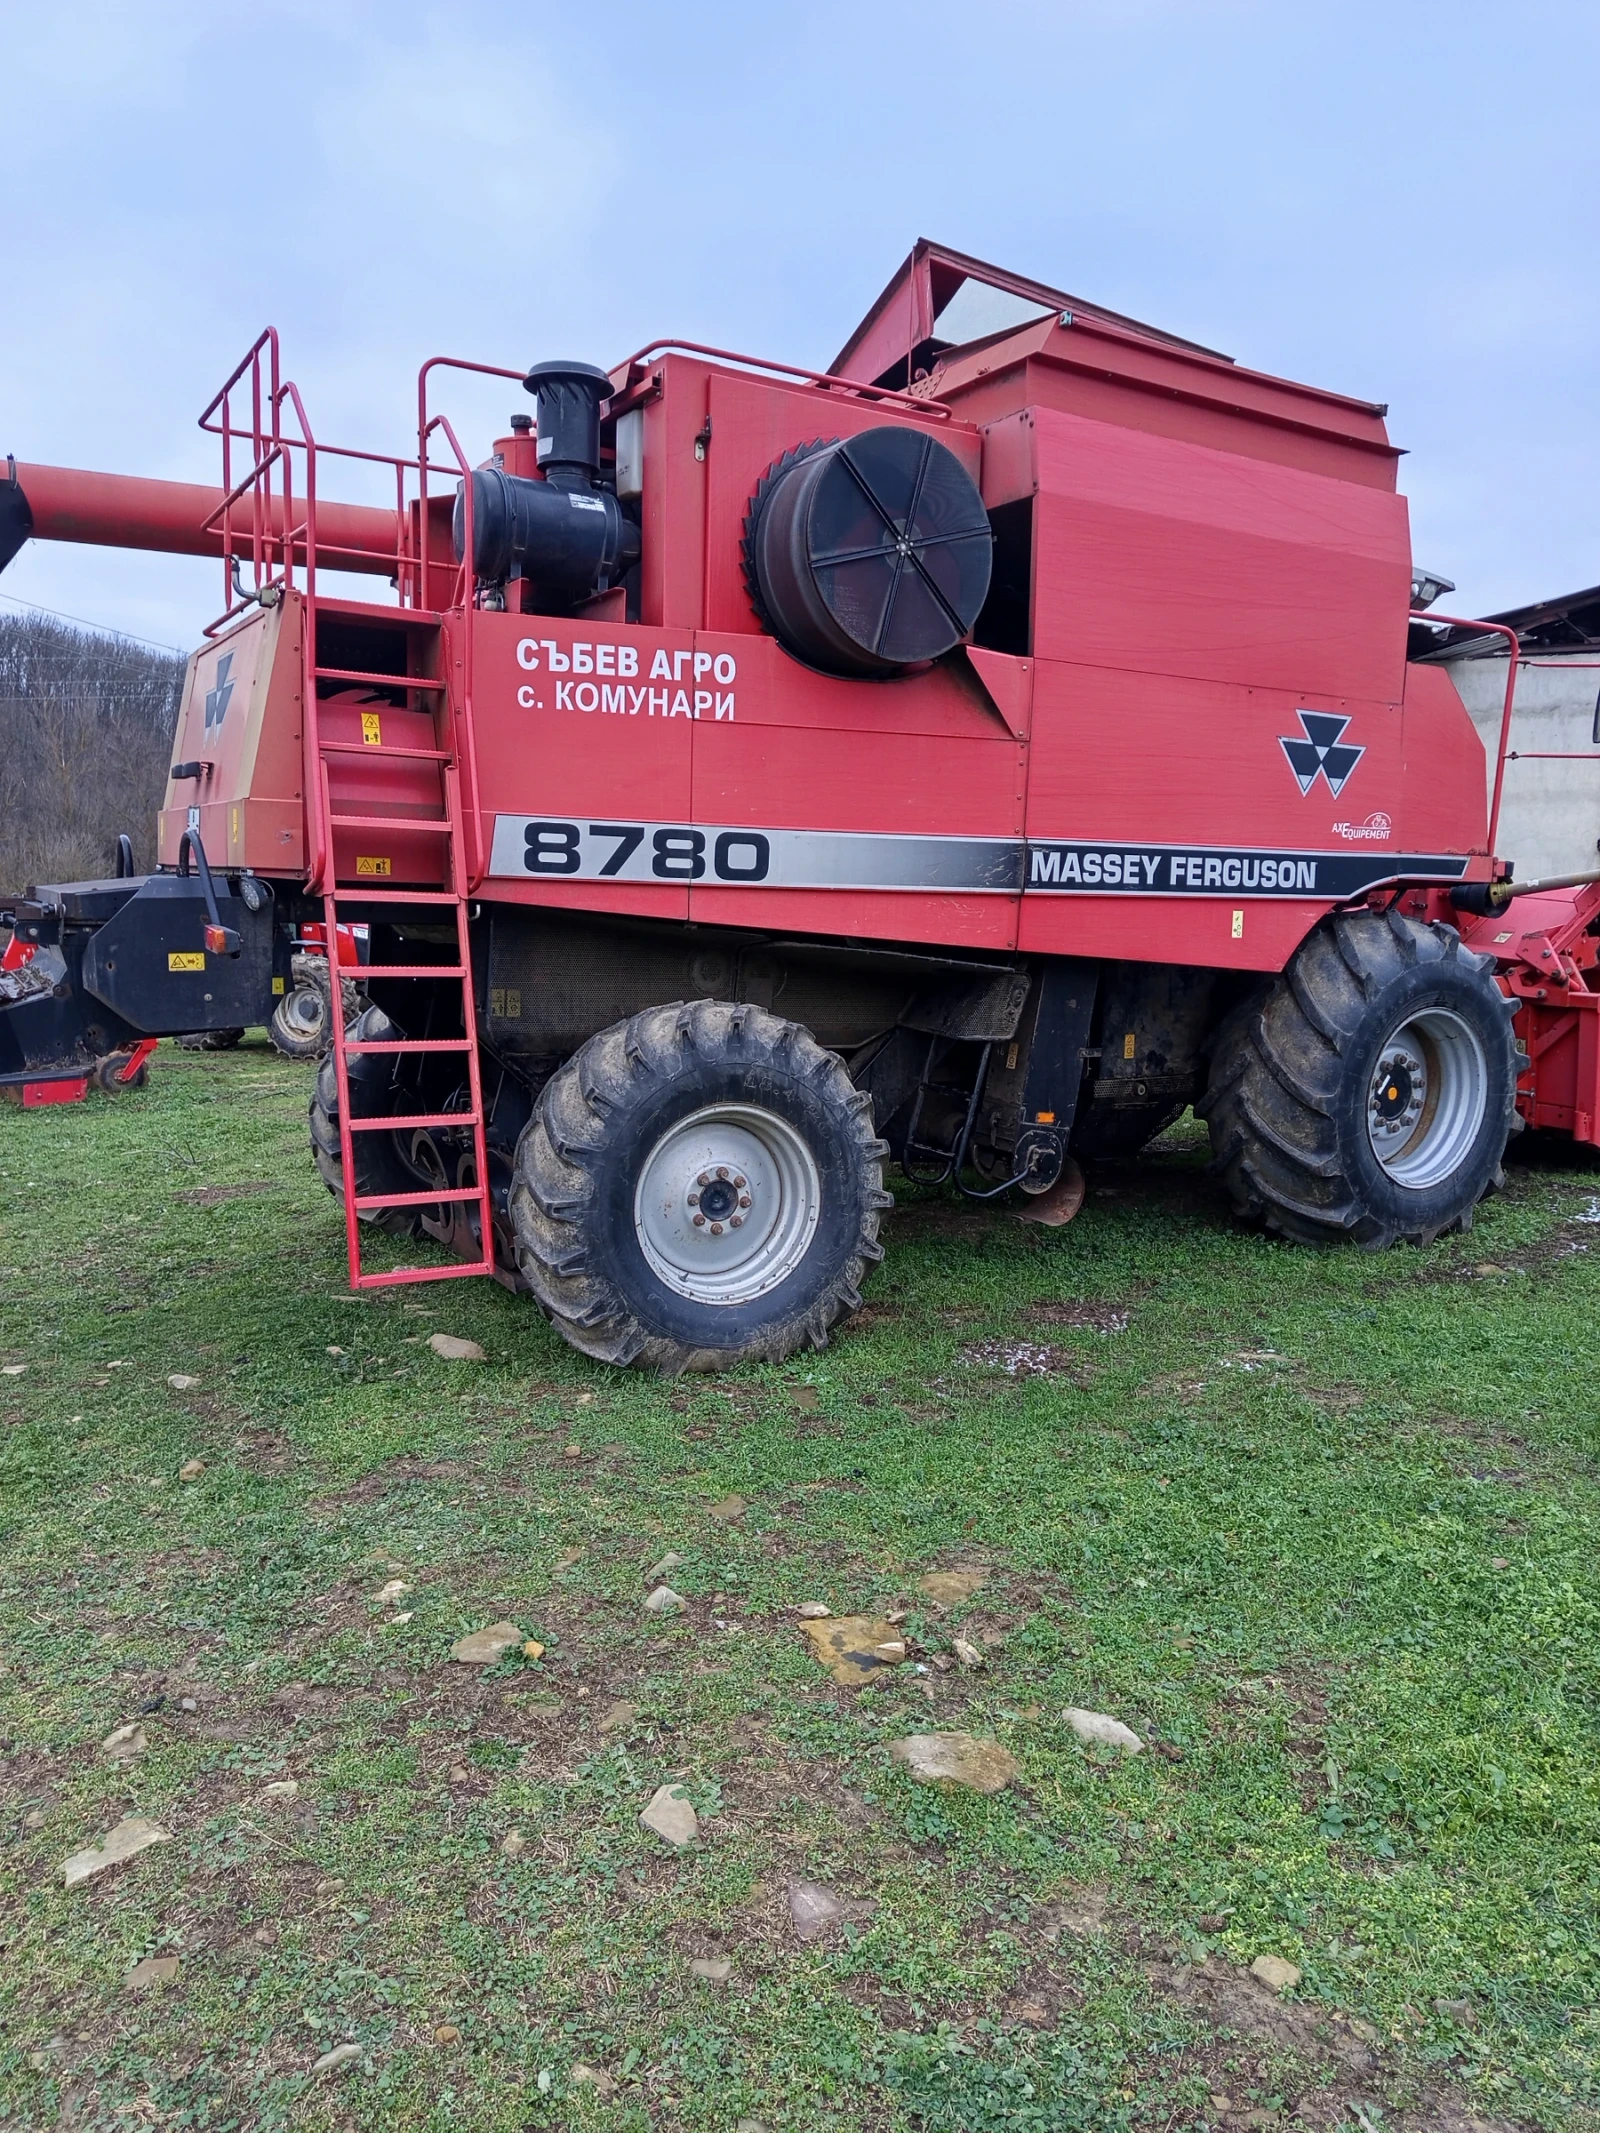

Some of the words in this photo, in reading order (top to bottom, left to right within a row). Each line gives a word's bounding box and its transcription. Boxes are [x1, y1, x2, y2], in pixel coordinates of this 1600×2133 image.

[517, 638, 639, 678] СЪБЕВ
[649, 649, 737, 684] АГРО
[517, 684, 543, 709] с.
[555, 680, 736, 721] КОМУНАРИ
[524, 822, 771, 882] 8780
[1030, 851, 1162, 885] MASSEY
[1169, 856, 1317, 889] FERGUSON
